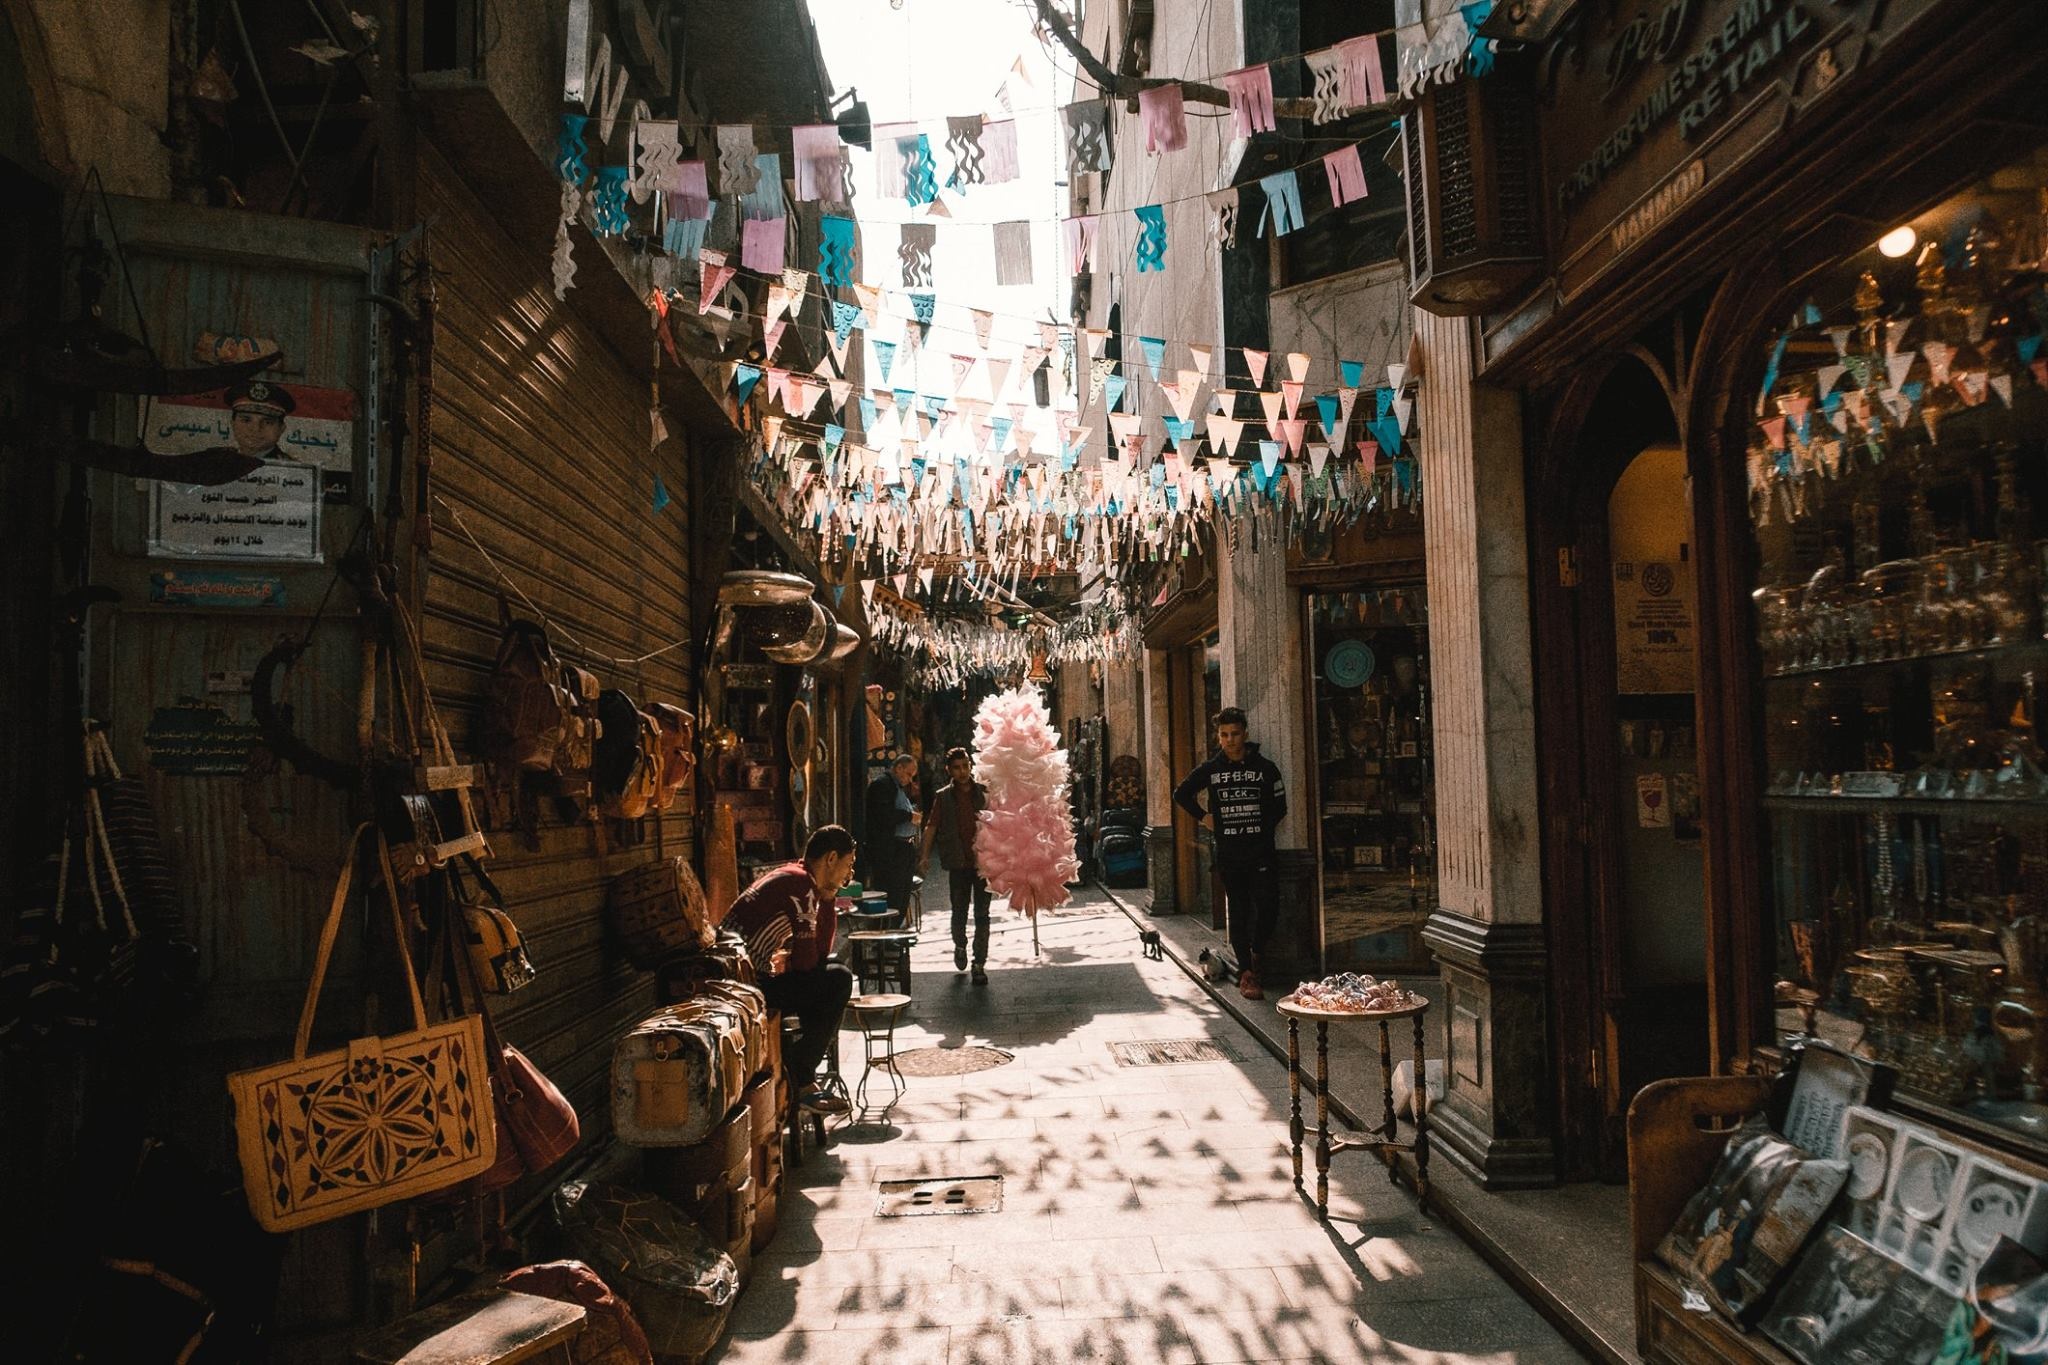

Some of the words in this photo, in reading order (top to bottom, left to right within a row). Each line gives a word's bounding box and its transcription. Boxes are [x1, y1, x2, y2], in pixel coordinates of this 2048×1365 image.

[1679, 5, 1811, 140] RETAIL
[217, 420, 230, 440] يا
[286, 430, 338, 451] بنحبك
[243, 535, 263, 546] خلال
